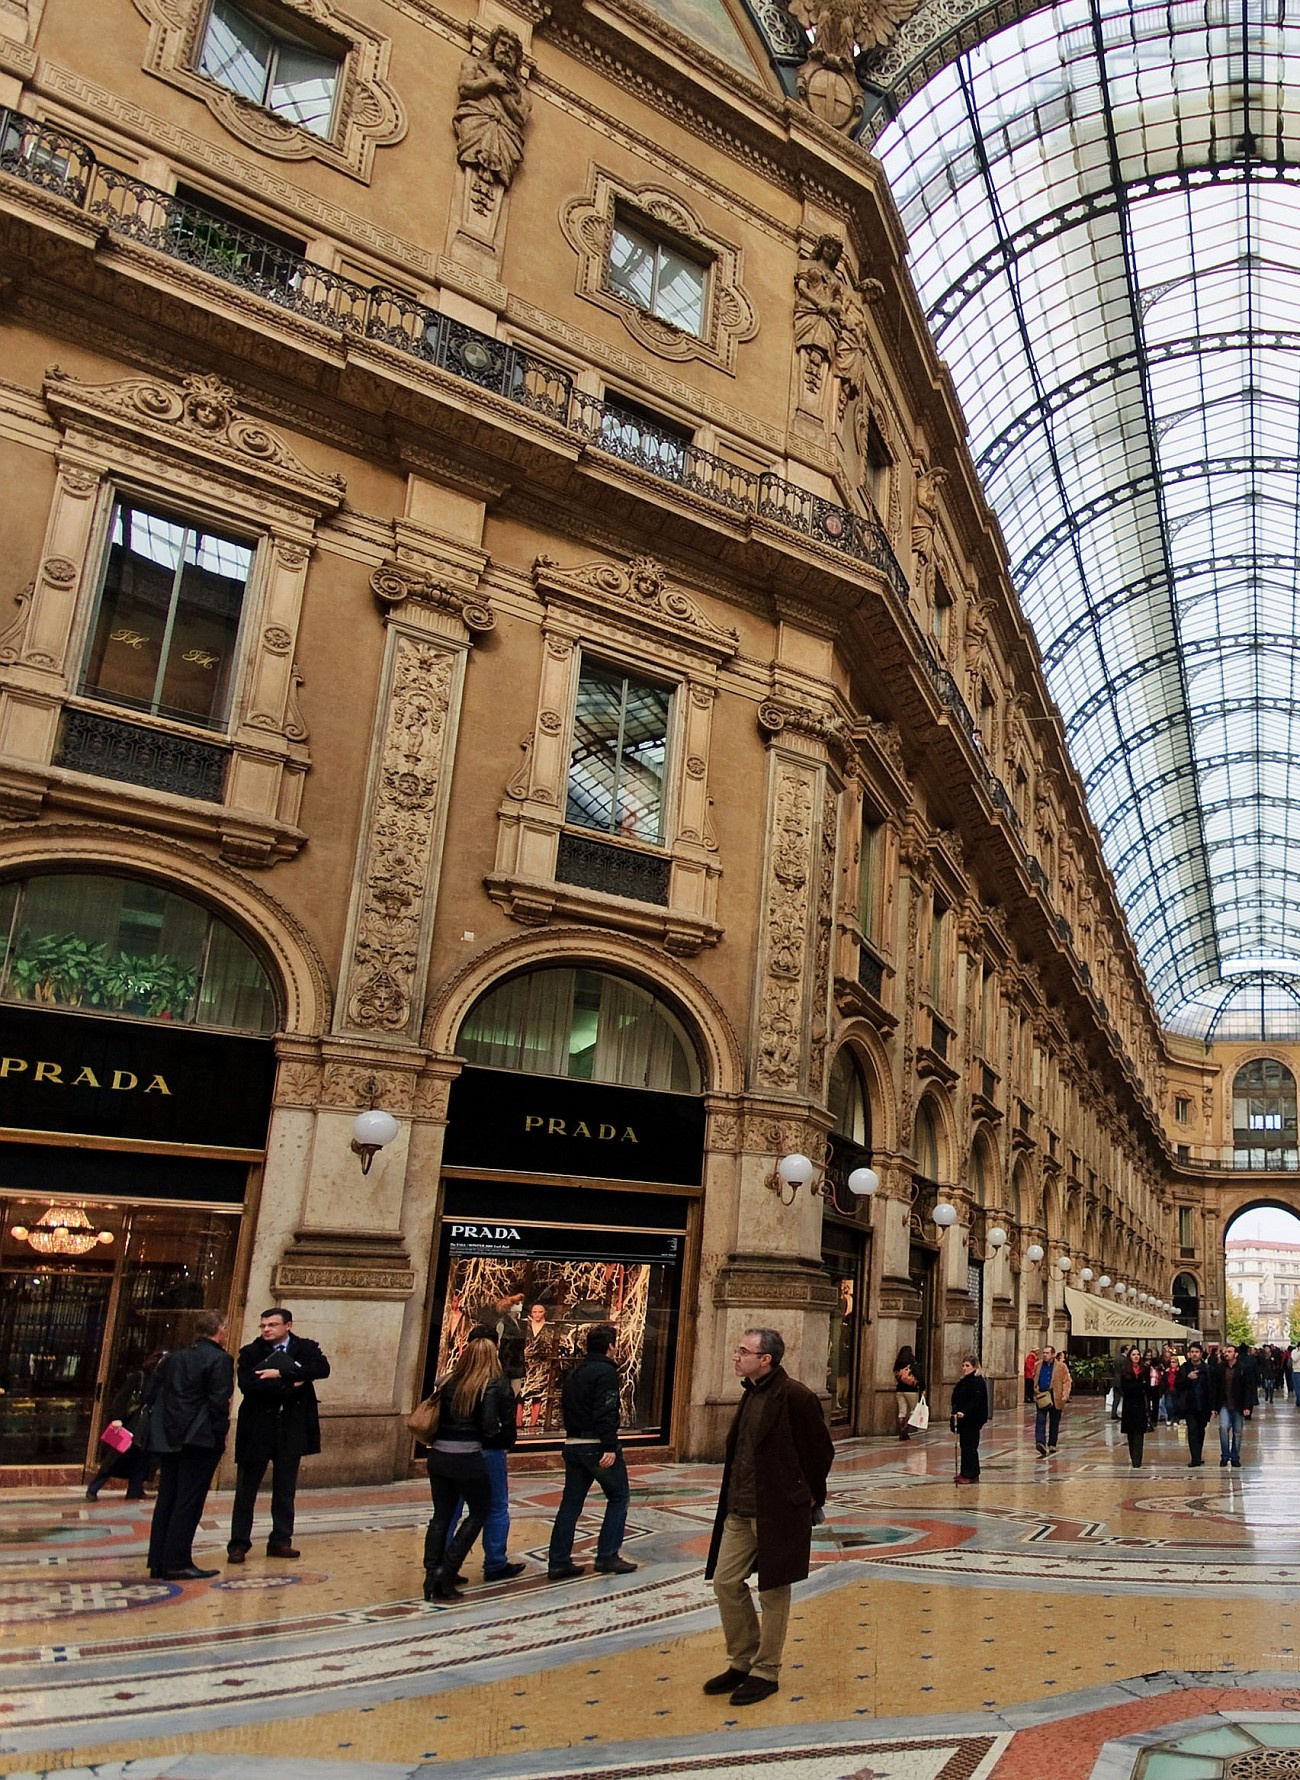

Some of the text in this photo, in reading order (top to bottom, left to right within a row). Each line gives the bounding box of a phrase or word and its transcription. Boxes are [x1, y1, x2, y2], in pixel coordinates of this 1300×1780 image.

[0, 1057, 174, 1096] PRADA
[525, 1115, 639, 1143] PRADA
[451, 1225, 521, 1240] PRADA
[1102, 1311, 1158, 1328] Galleria
